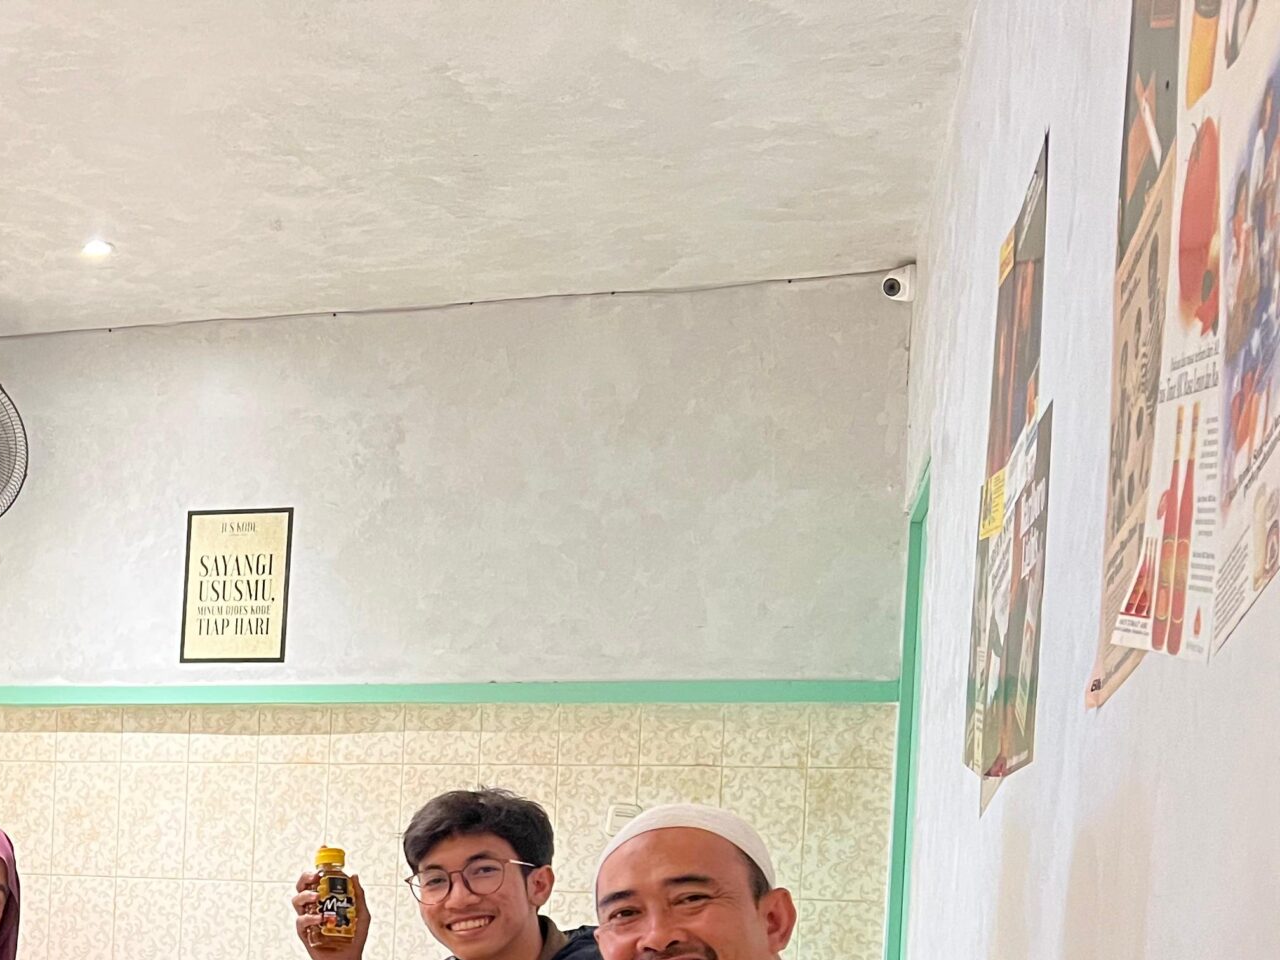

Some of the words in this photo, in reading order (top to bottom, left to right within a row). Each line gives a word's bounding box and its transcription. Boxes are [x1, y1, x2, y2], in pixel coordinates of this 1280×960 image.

[199, 553, 273, 577] SAYANGI
[199, 579, 275, 603] USUSMU,
[197, 605, 223, 616] MINUM
[250, 604, 271, 616] KODE
[197, 618, 230, 636] TIAP
[234, 617, 270, 635] HARI
